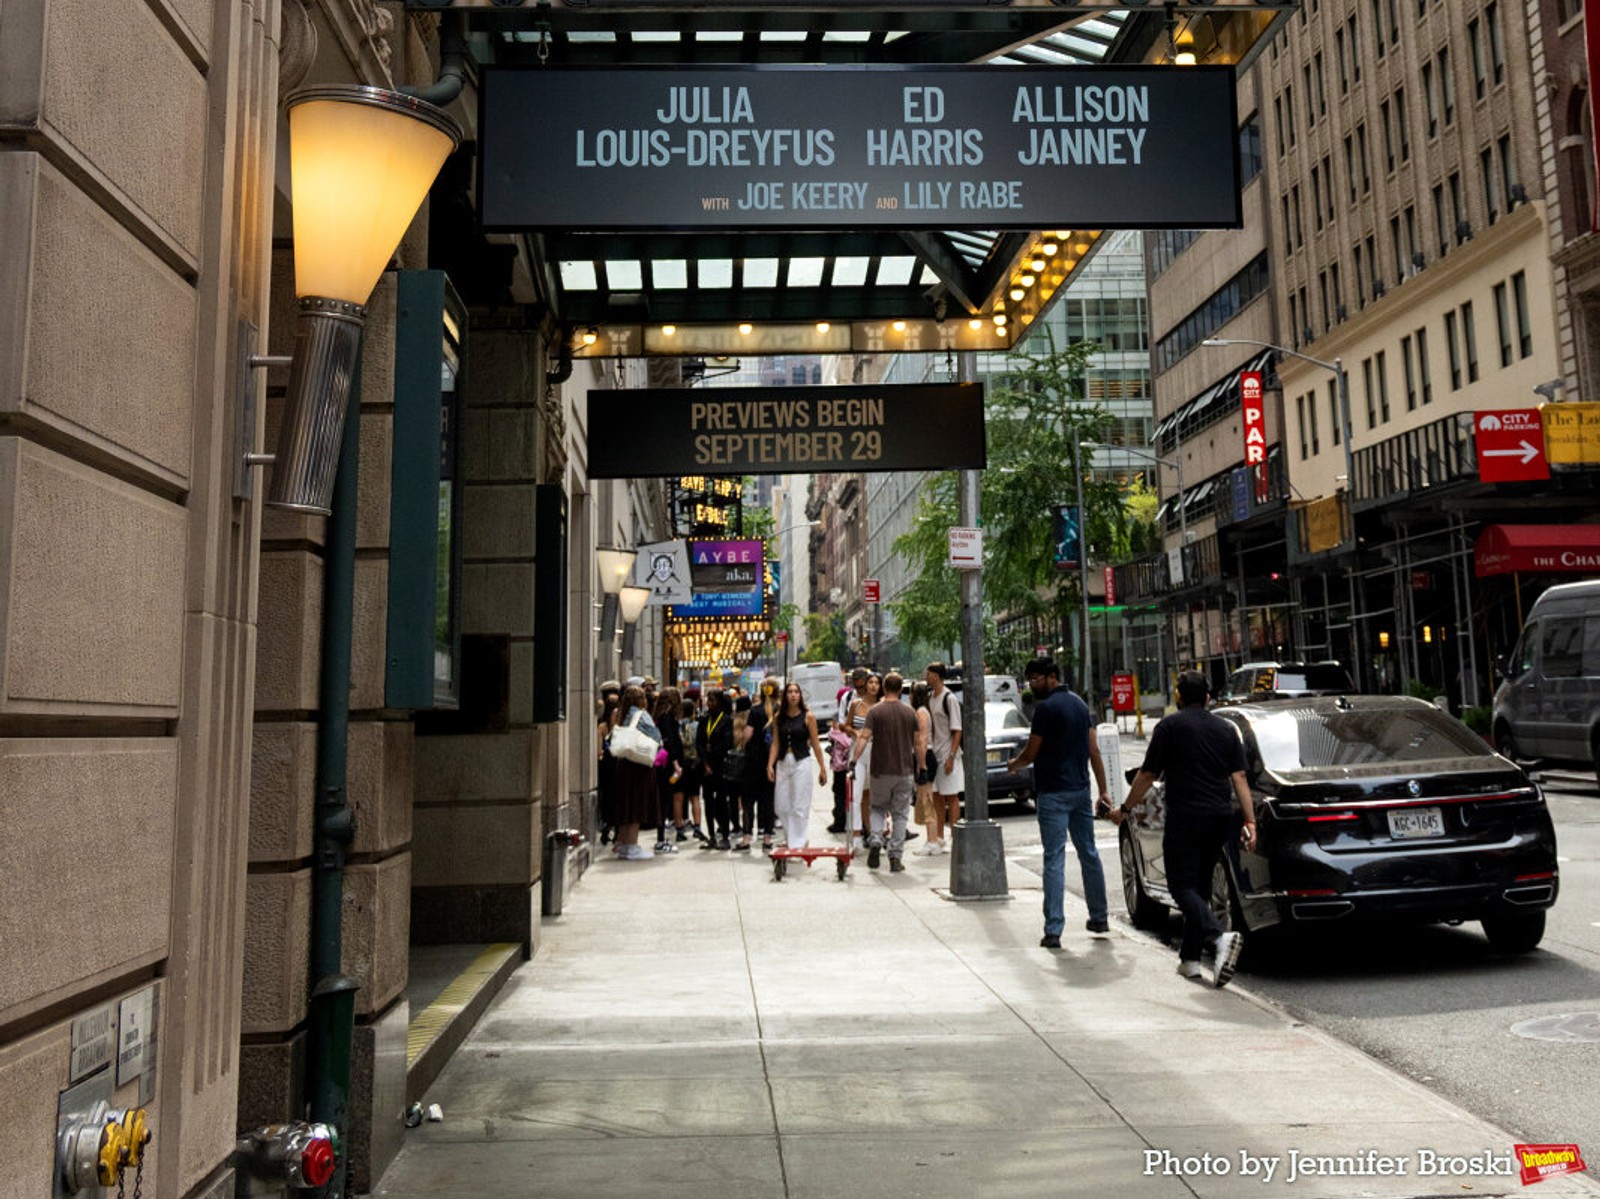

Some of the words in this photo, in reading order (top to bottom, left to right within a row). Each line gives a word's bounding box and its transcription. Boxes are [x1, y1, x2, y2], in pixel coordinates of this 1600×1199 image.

[656, 86, 755, 124] JULIA
[903, 86, 945, 122] ED
[1012, 85, 1149, 124] ALLISON
[576, 129, 836, 168] LOUIS-DREYFUS
[866, 130, 984, 167] HARRIS
[1017, 128, 1147, 166] JANNEY
[701, 197, 730, 211] WITH
[738, 183, 784, 211] JOE
[792, 183, 868, 211] KEERY
[876, 196, 898, 211] AND
[904, 182, 953, 211] LILY
[959, 181, 1023, 211] RABE
[690, 401, 810, 431] PREVIEWS
[817, 398, 885, 429] BEGIN
[1502, 413, 1531, 424] CITY
[1503, 423, 1540, 431] PARKING
[694, 433, 844, 464] SEPTEMBER
[850, 431, 883, 460] 29
[698, 551, 751, 564] AYBE
[1534, 557, 1555, 566] THE
[726, 568, 754, 582] aka.
